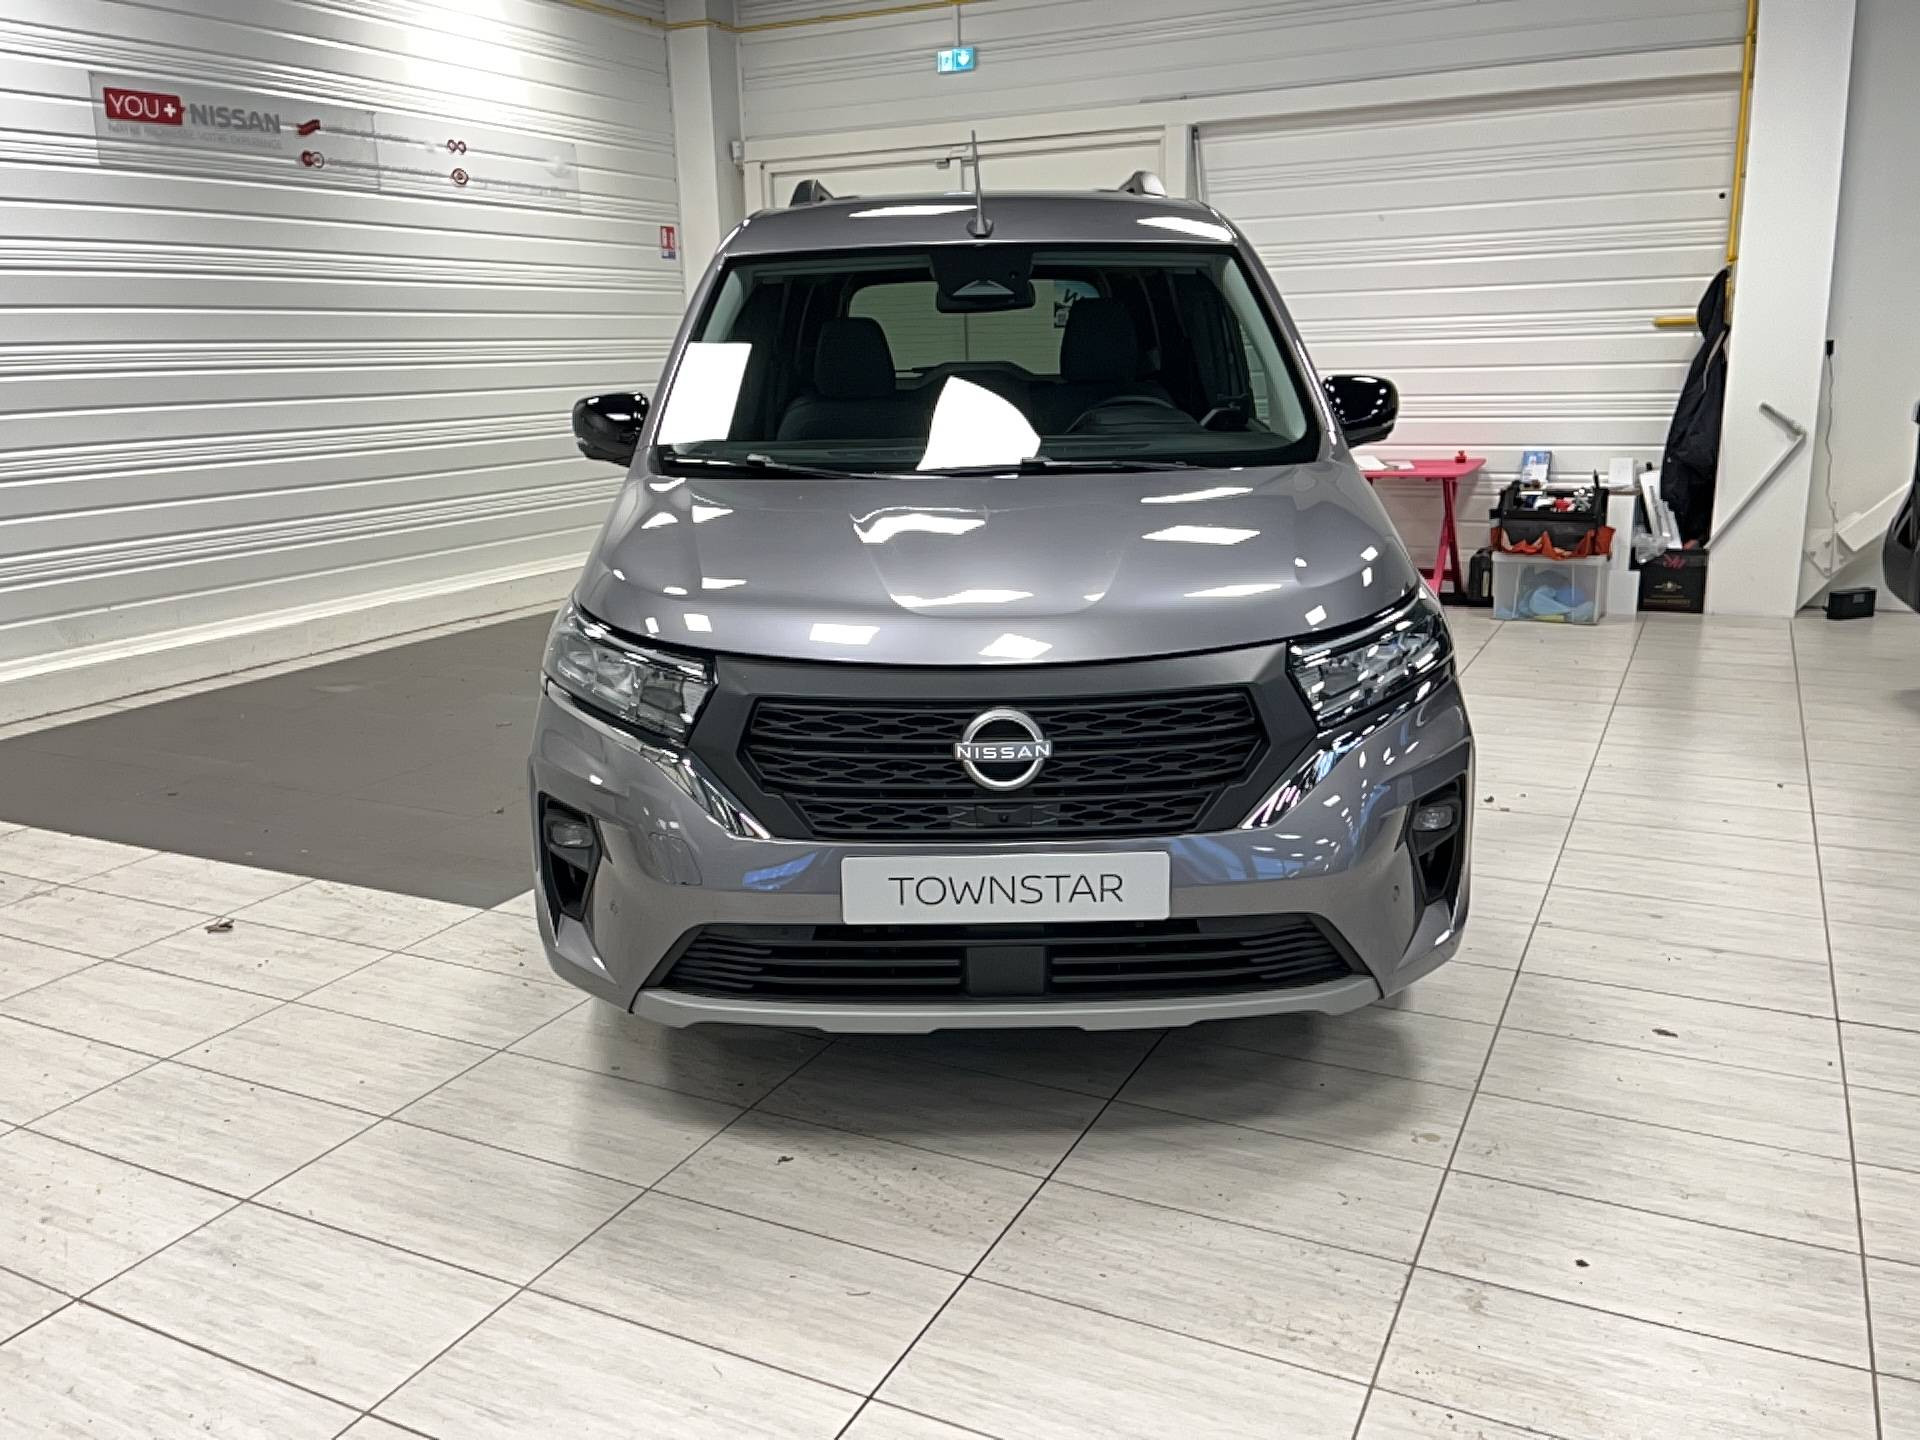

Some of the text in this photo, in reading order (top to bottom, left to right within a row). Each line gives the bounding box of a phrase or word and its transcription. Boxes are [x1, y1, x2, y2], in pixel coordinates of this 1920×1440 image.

[189, 103, 282, 134] NISSAN
[956, 743, 1050, 760] NISSAN
[887, 873, 1124, 906] TOWNSTAR
